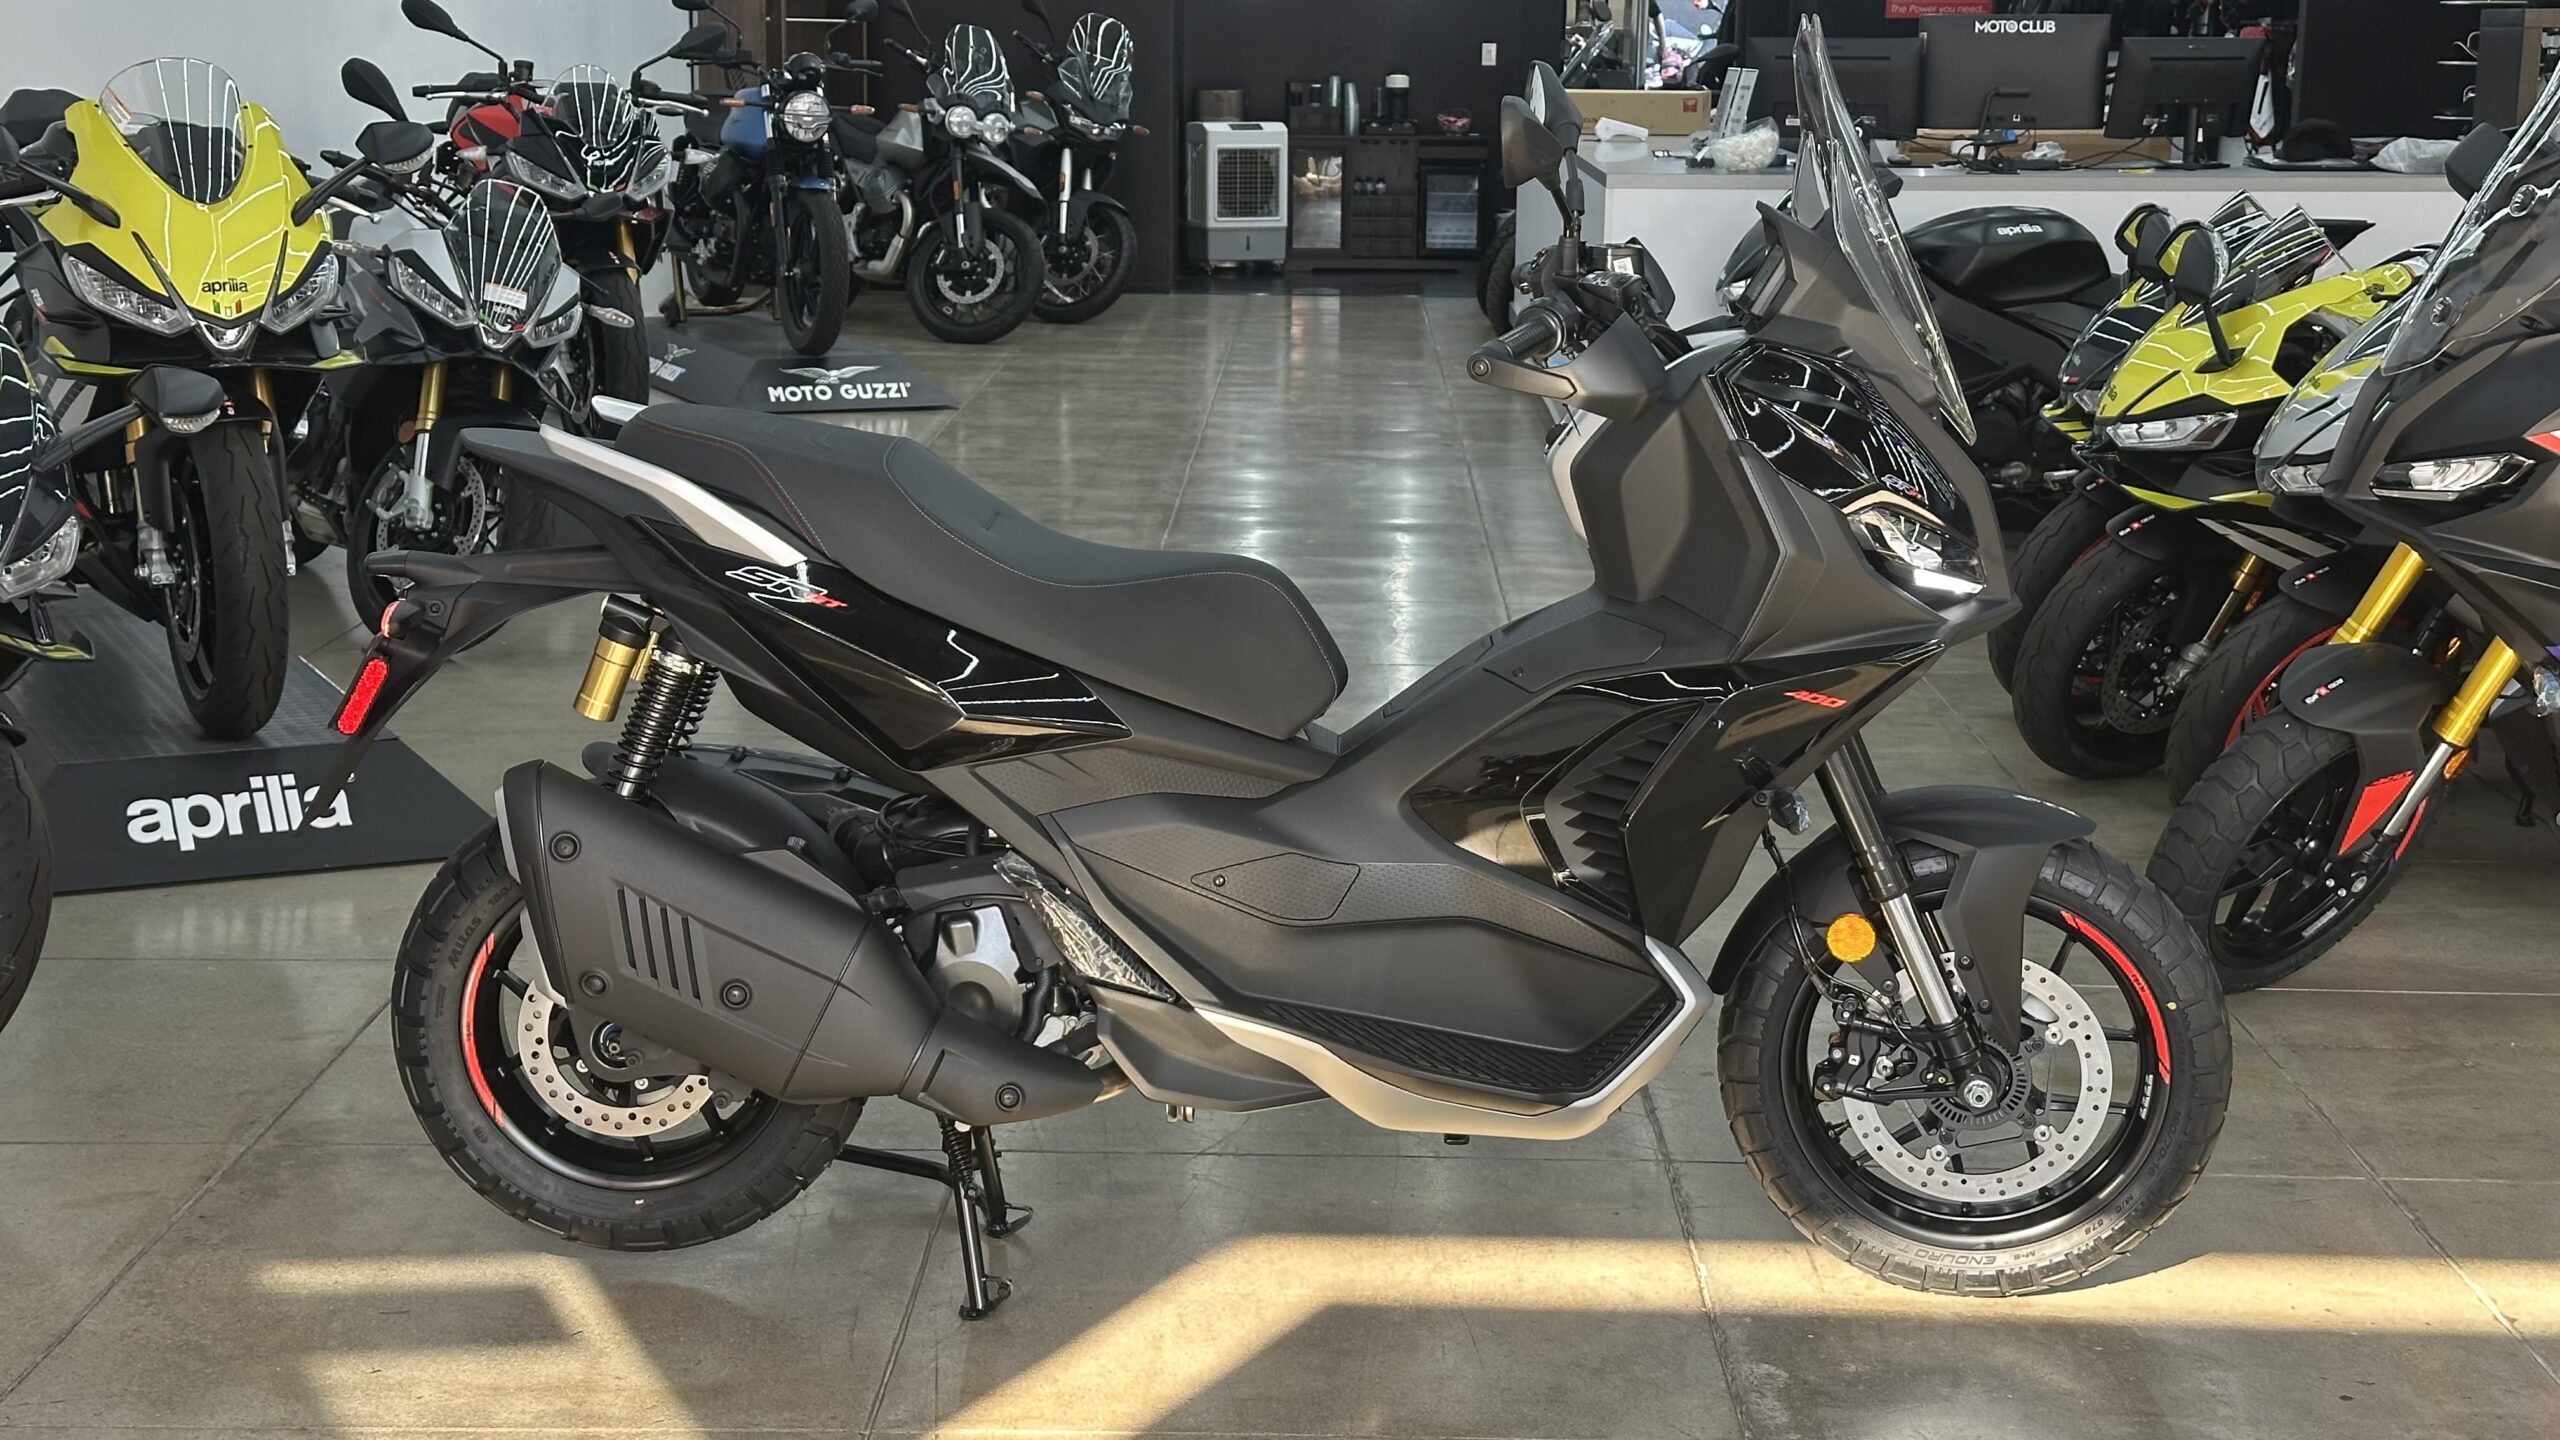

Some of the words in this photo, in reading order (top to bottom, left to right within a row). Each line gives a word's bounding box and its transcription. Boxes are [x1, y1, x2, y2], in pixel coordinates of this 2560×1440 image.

[1891, 4, 1906, 13] The
[1908, 4, 1938, 13] Power
[1996, 223, 2044, 236] aprilia
[201, 278, 248, 295] aprilia
[767, 385, 832, 402] MOTO
[840, 382, 908, 400] GUZZI
[1783, 691, 1848, 708] 400
[1915, 1249, 1997, 1266] ENDURO
